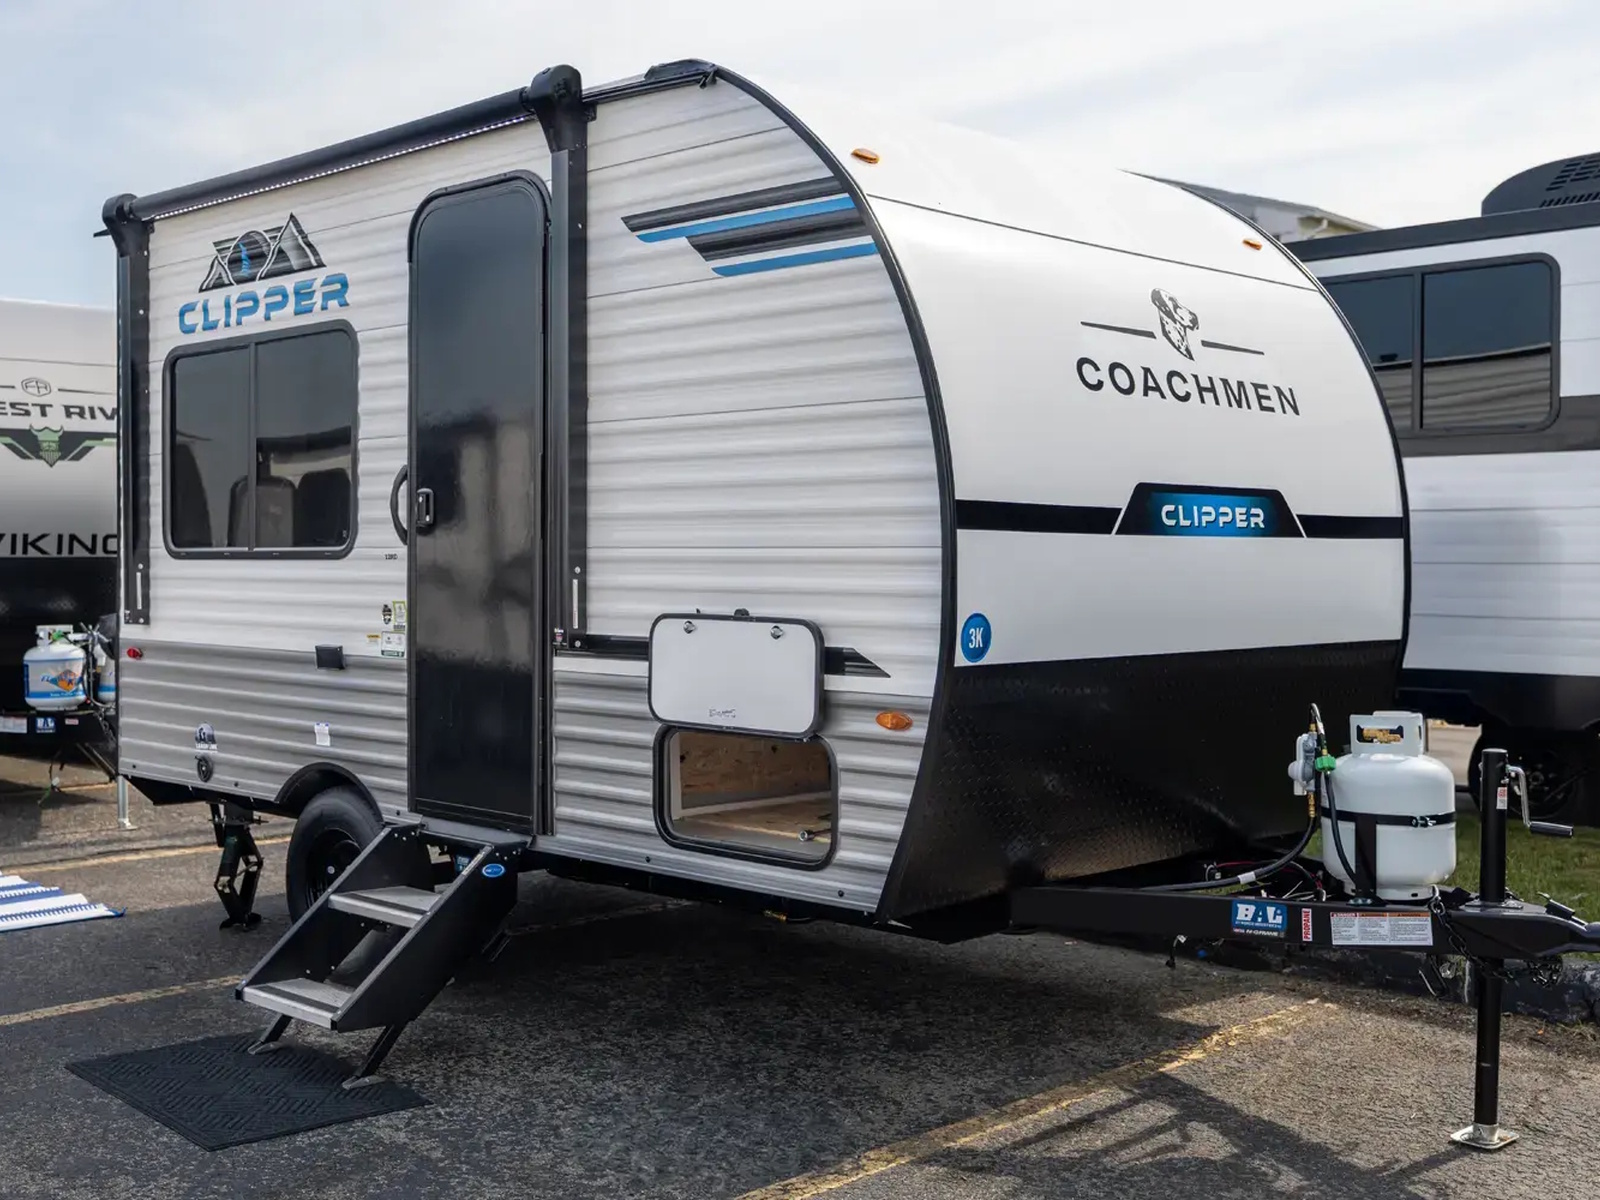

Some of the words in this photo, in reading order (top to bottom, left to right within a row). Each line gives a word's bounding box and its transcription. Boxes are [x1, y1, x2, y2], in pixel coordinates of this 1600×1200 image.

[179, 273, 350, 334] CLIPPER
[1076, 357, 1300, 416] COACHMEN
[1161, 504, 1265, 528] CLIPPER
[0, 533, 117, 555] IKIN
[969, 627, 984, 648] 3K
[1236, 903, 1283, 924] BAL
[1303, 910, 1311, 939] PROPANE
